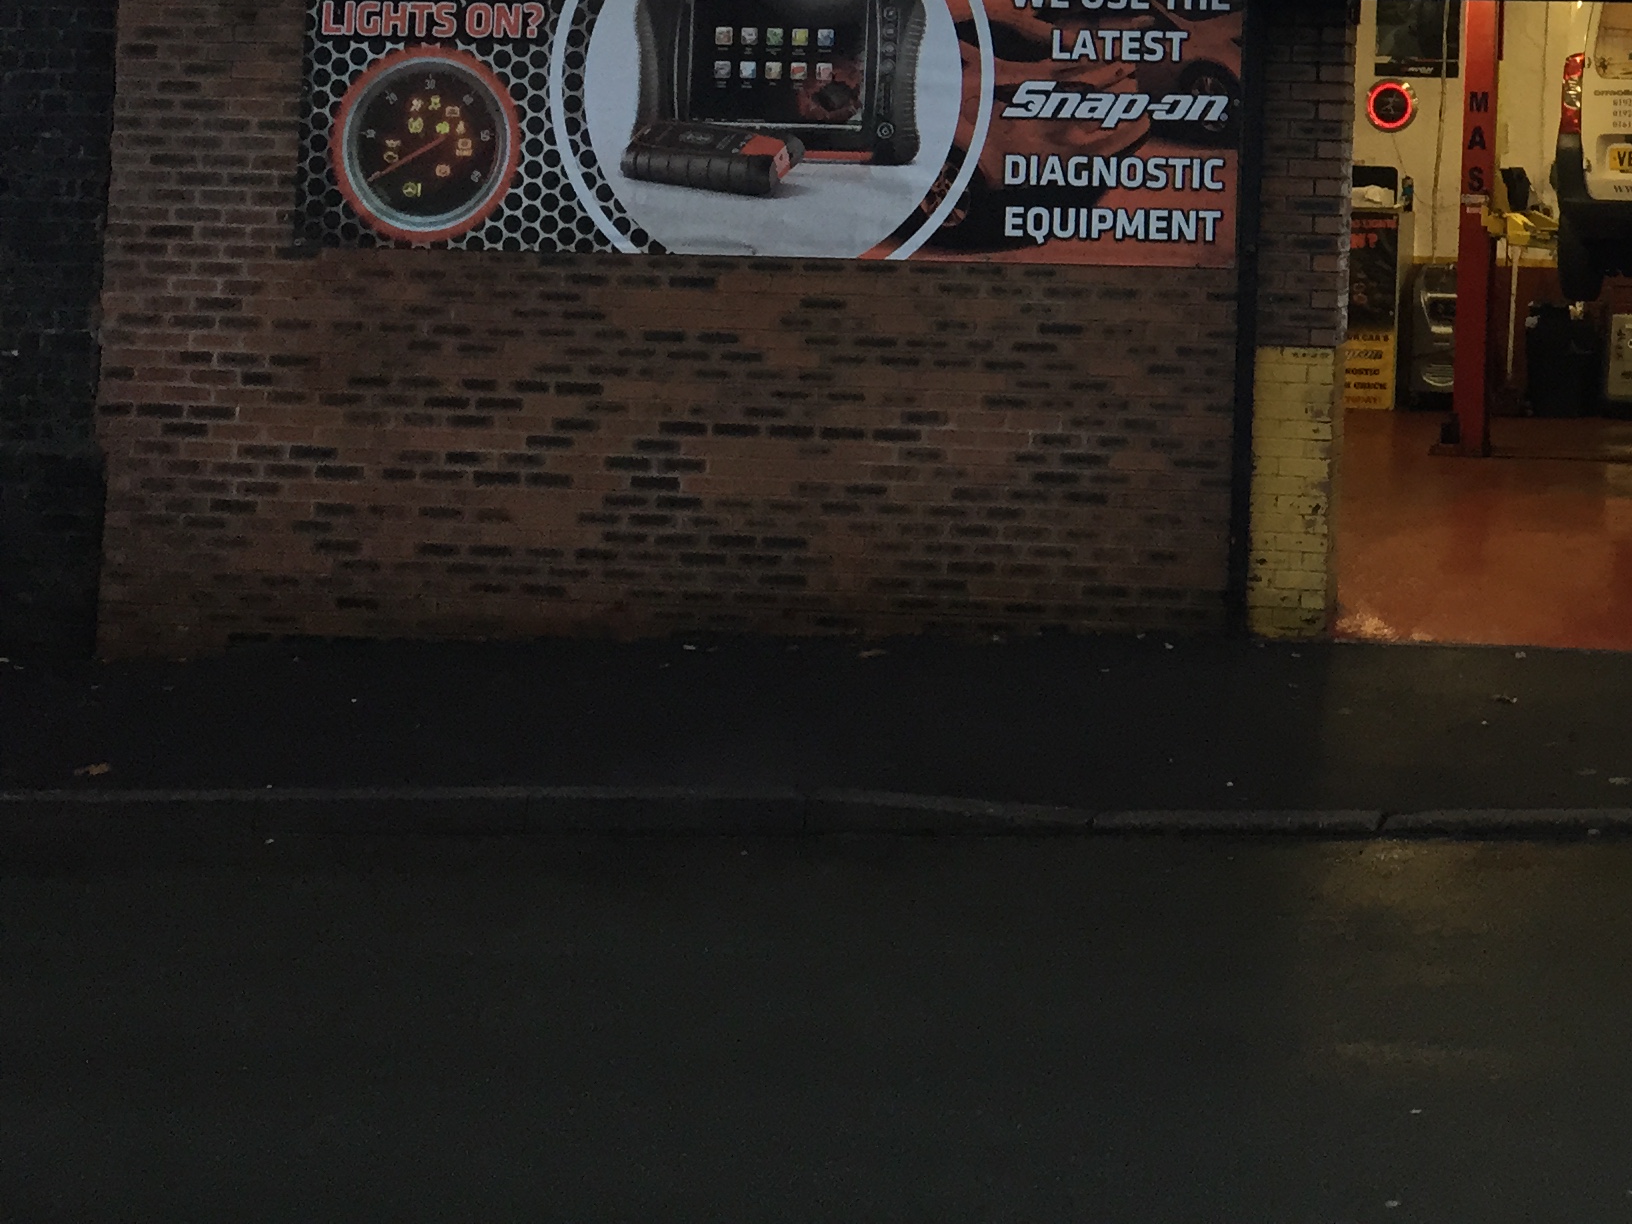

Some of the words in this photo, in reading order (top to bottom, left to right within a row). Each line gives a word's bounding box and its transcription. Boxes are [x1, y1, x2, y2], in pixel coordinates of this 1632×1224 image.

[321, 0, 458, 38] LIGHTS
[465, 2, 545, 38] ON?
[1052, 29, 1189, 62] LATEST
[1002, 81, 1230, 128] Snap-on
[1004, 154, 1226, 190] DIAGNOSTIC
[1004, 206, 1223, 244] EQUIPMENT
